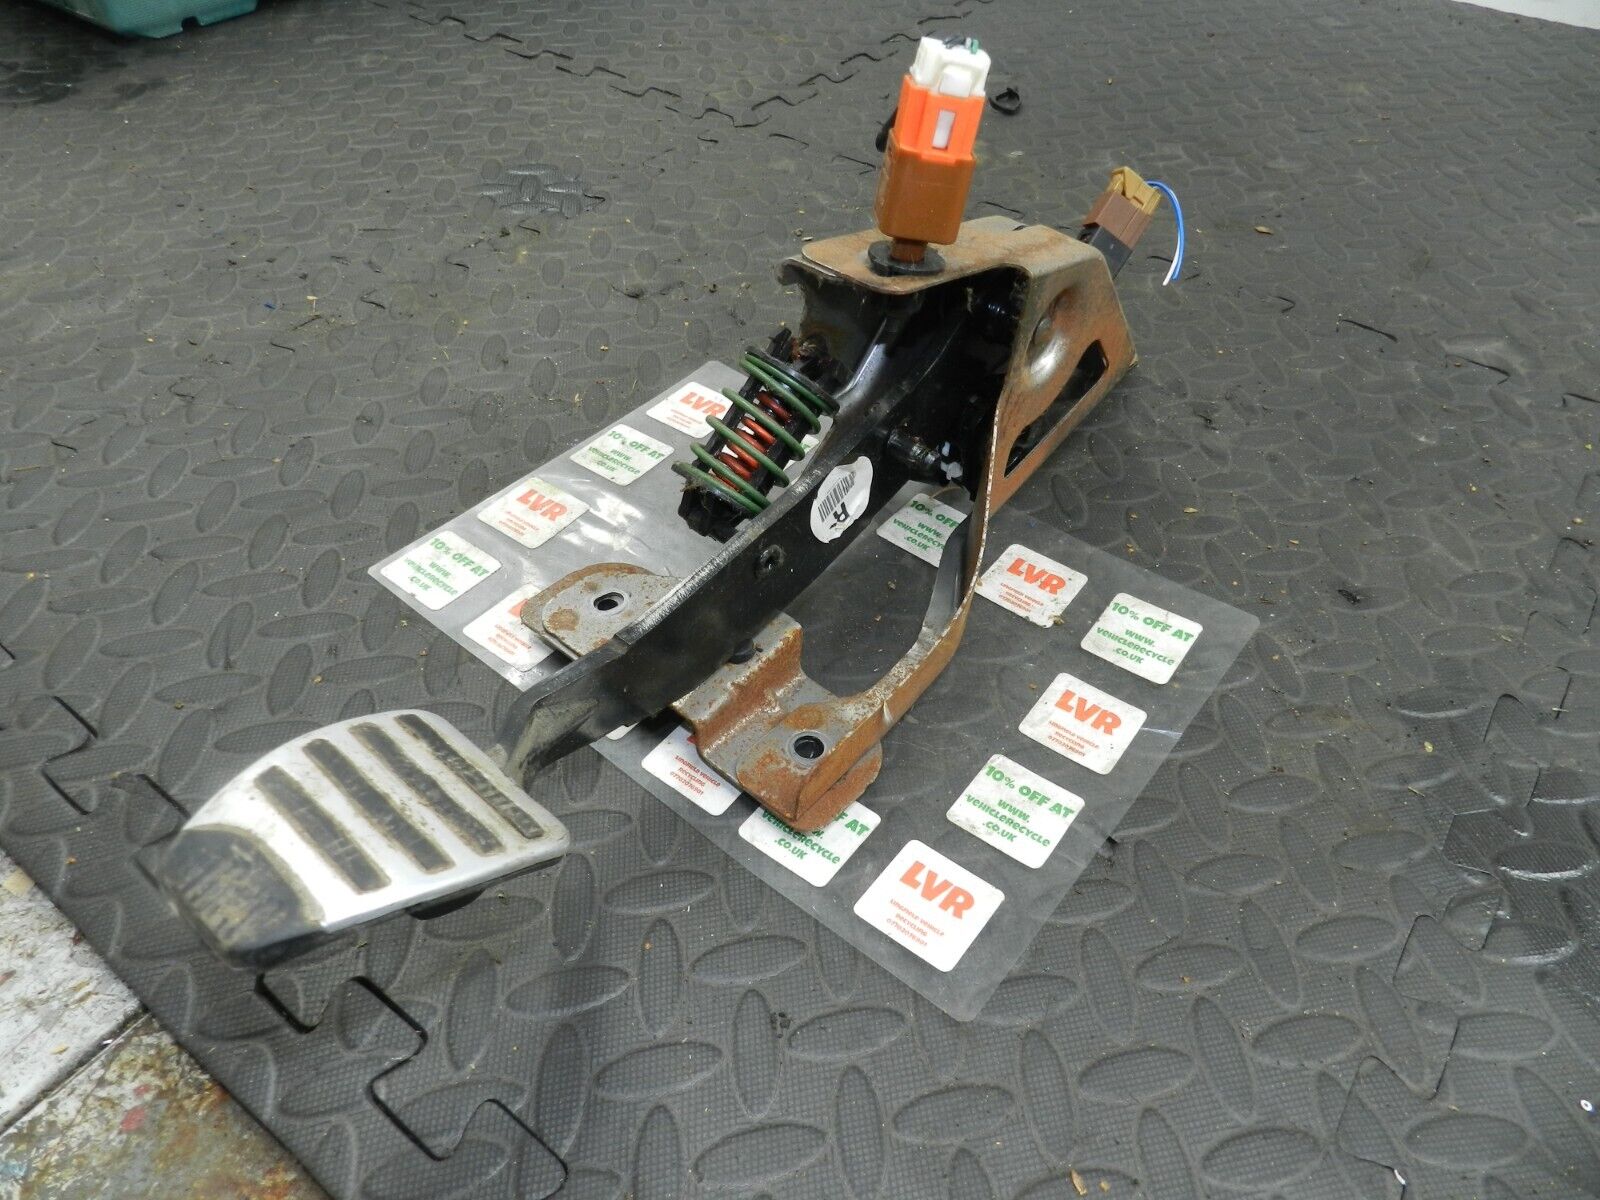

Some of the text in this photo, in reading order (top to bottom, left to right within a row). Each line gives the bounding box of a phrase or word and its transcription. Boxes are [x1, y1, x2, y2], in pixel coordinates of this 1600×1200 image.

[680, 391, 726, 417] LVR
[629, 441, 651, 452] OFF
[648, 450, 665, 459] AT
[516, 488, 568, 522] LVR
[910, 500, 960, 528] 10% OFF
[430, 538, 489, 576] 10% OFF AT
[1007, 557, 1066, 595] LVR
[1111, 602, 1194, 642] 10% OFF AT
[1055, 689, 1122, 735] LVR
[985, 765, 1075, 818] 10% OFF AT
[844, 819, 870, 836] AT
[899, 860, 975, 920] LVR
